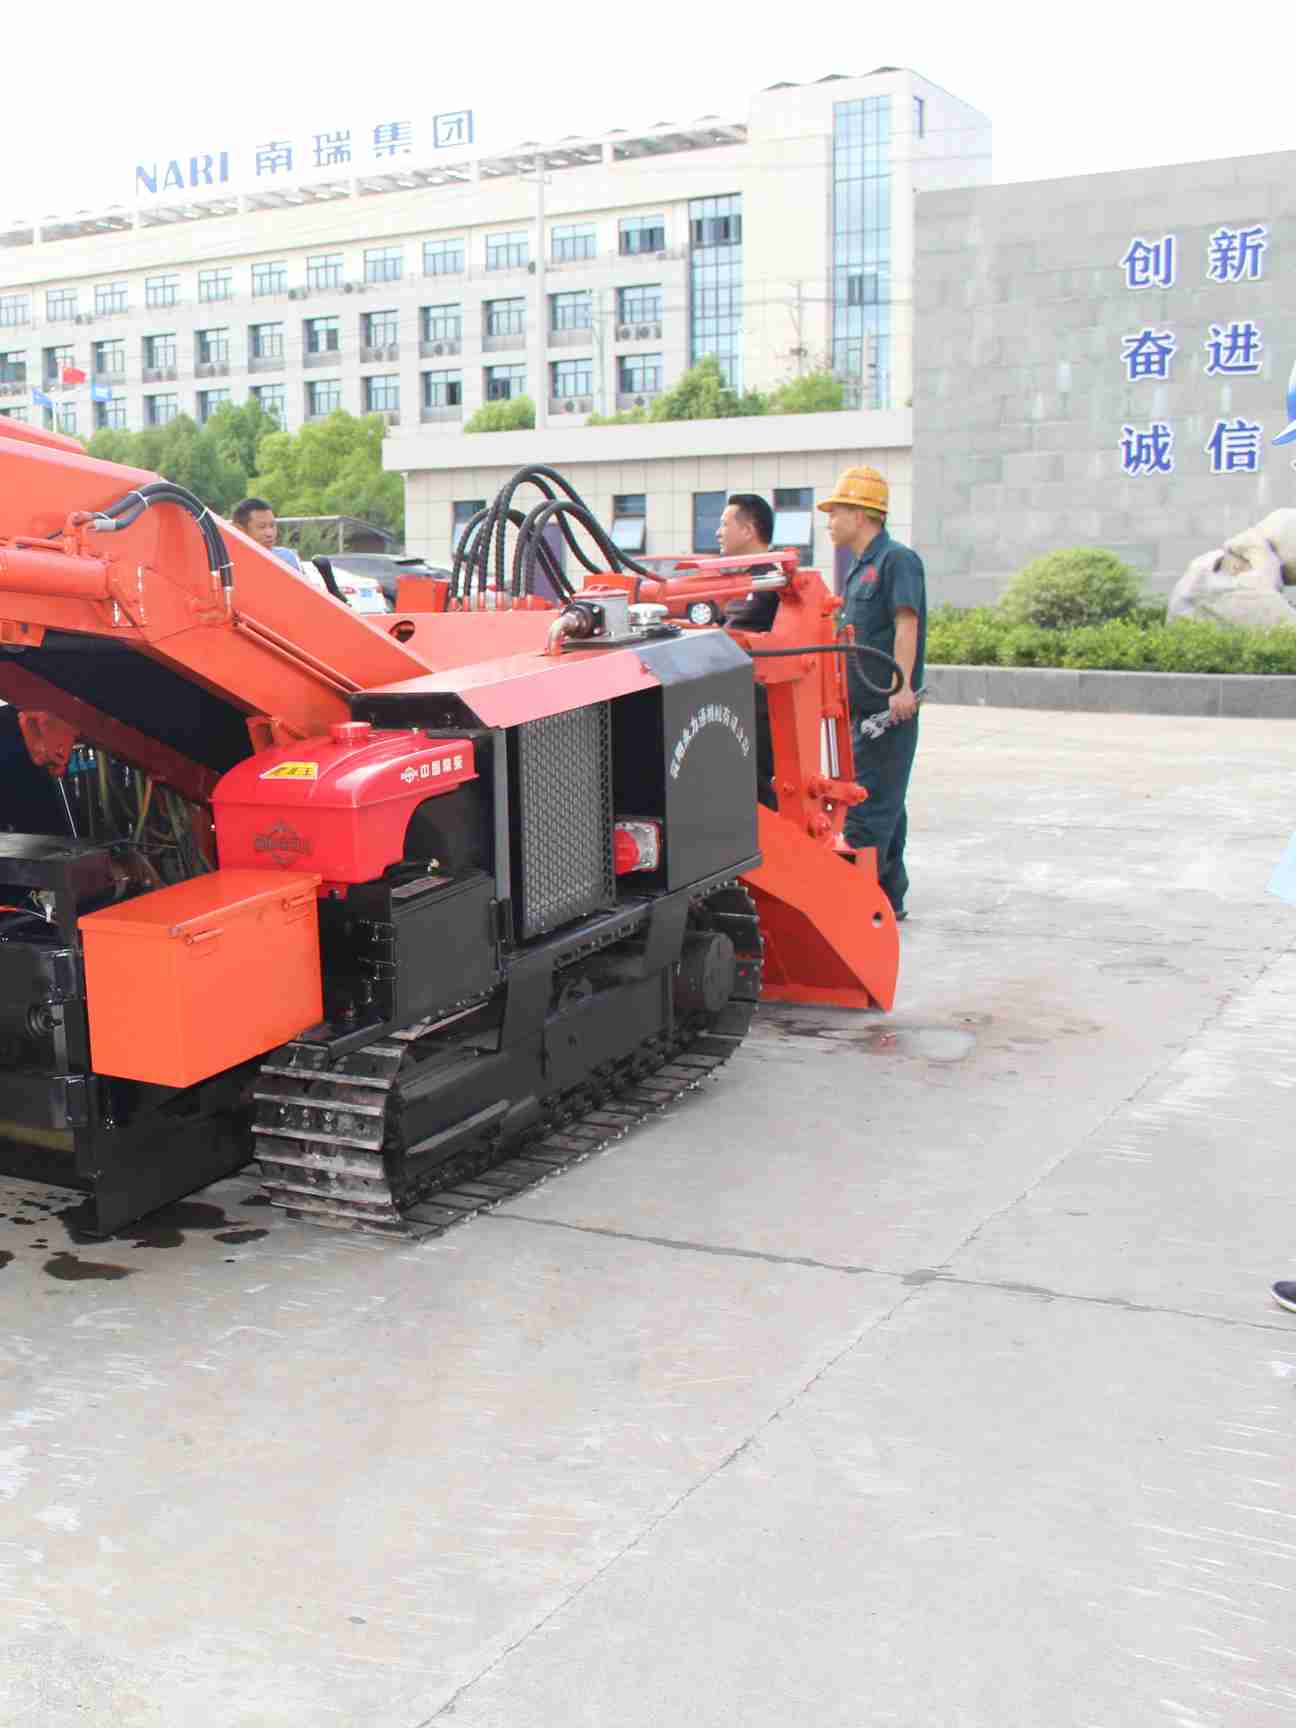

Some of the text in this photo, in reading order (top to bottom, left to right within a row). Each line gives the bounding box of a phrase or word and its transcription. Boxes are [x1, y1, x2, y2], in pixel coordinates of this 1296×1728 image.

[136, 109, 474, 195] NARI 南瑞集团
[1121, 226, 1265, 287] 创新
[1121, 322, 1260, 380] 奋进
[1119, 419, 1261, 474] 诚信
